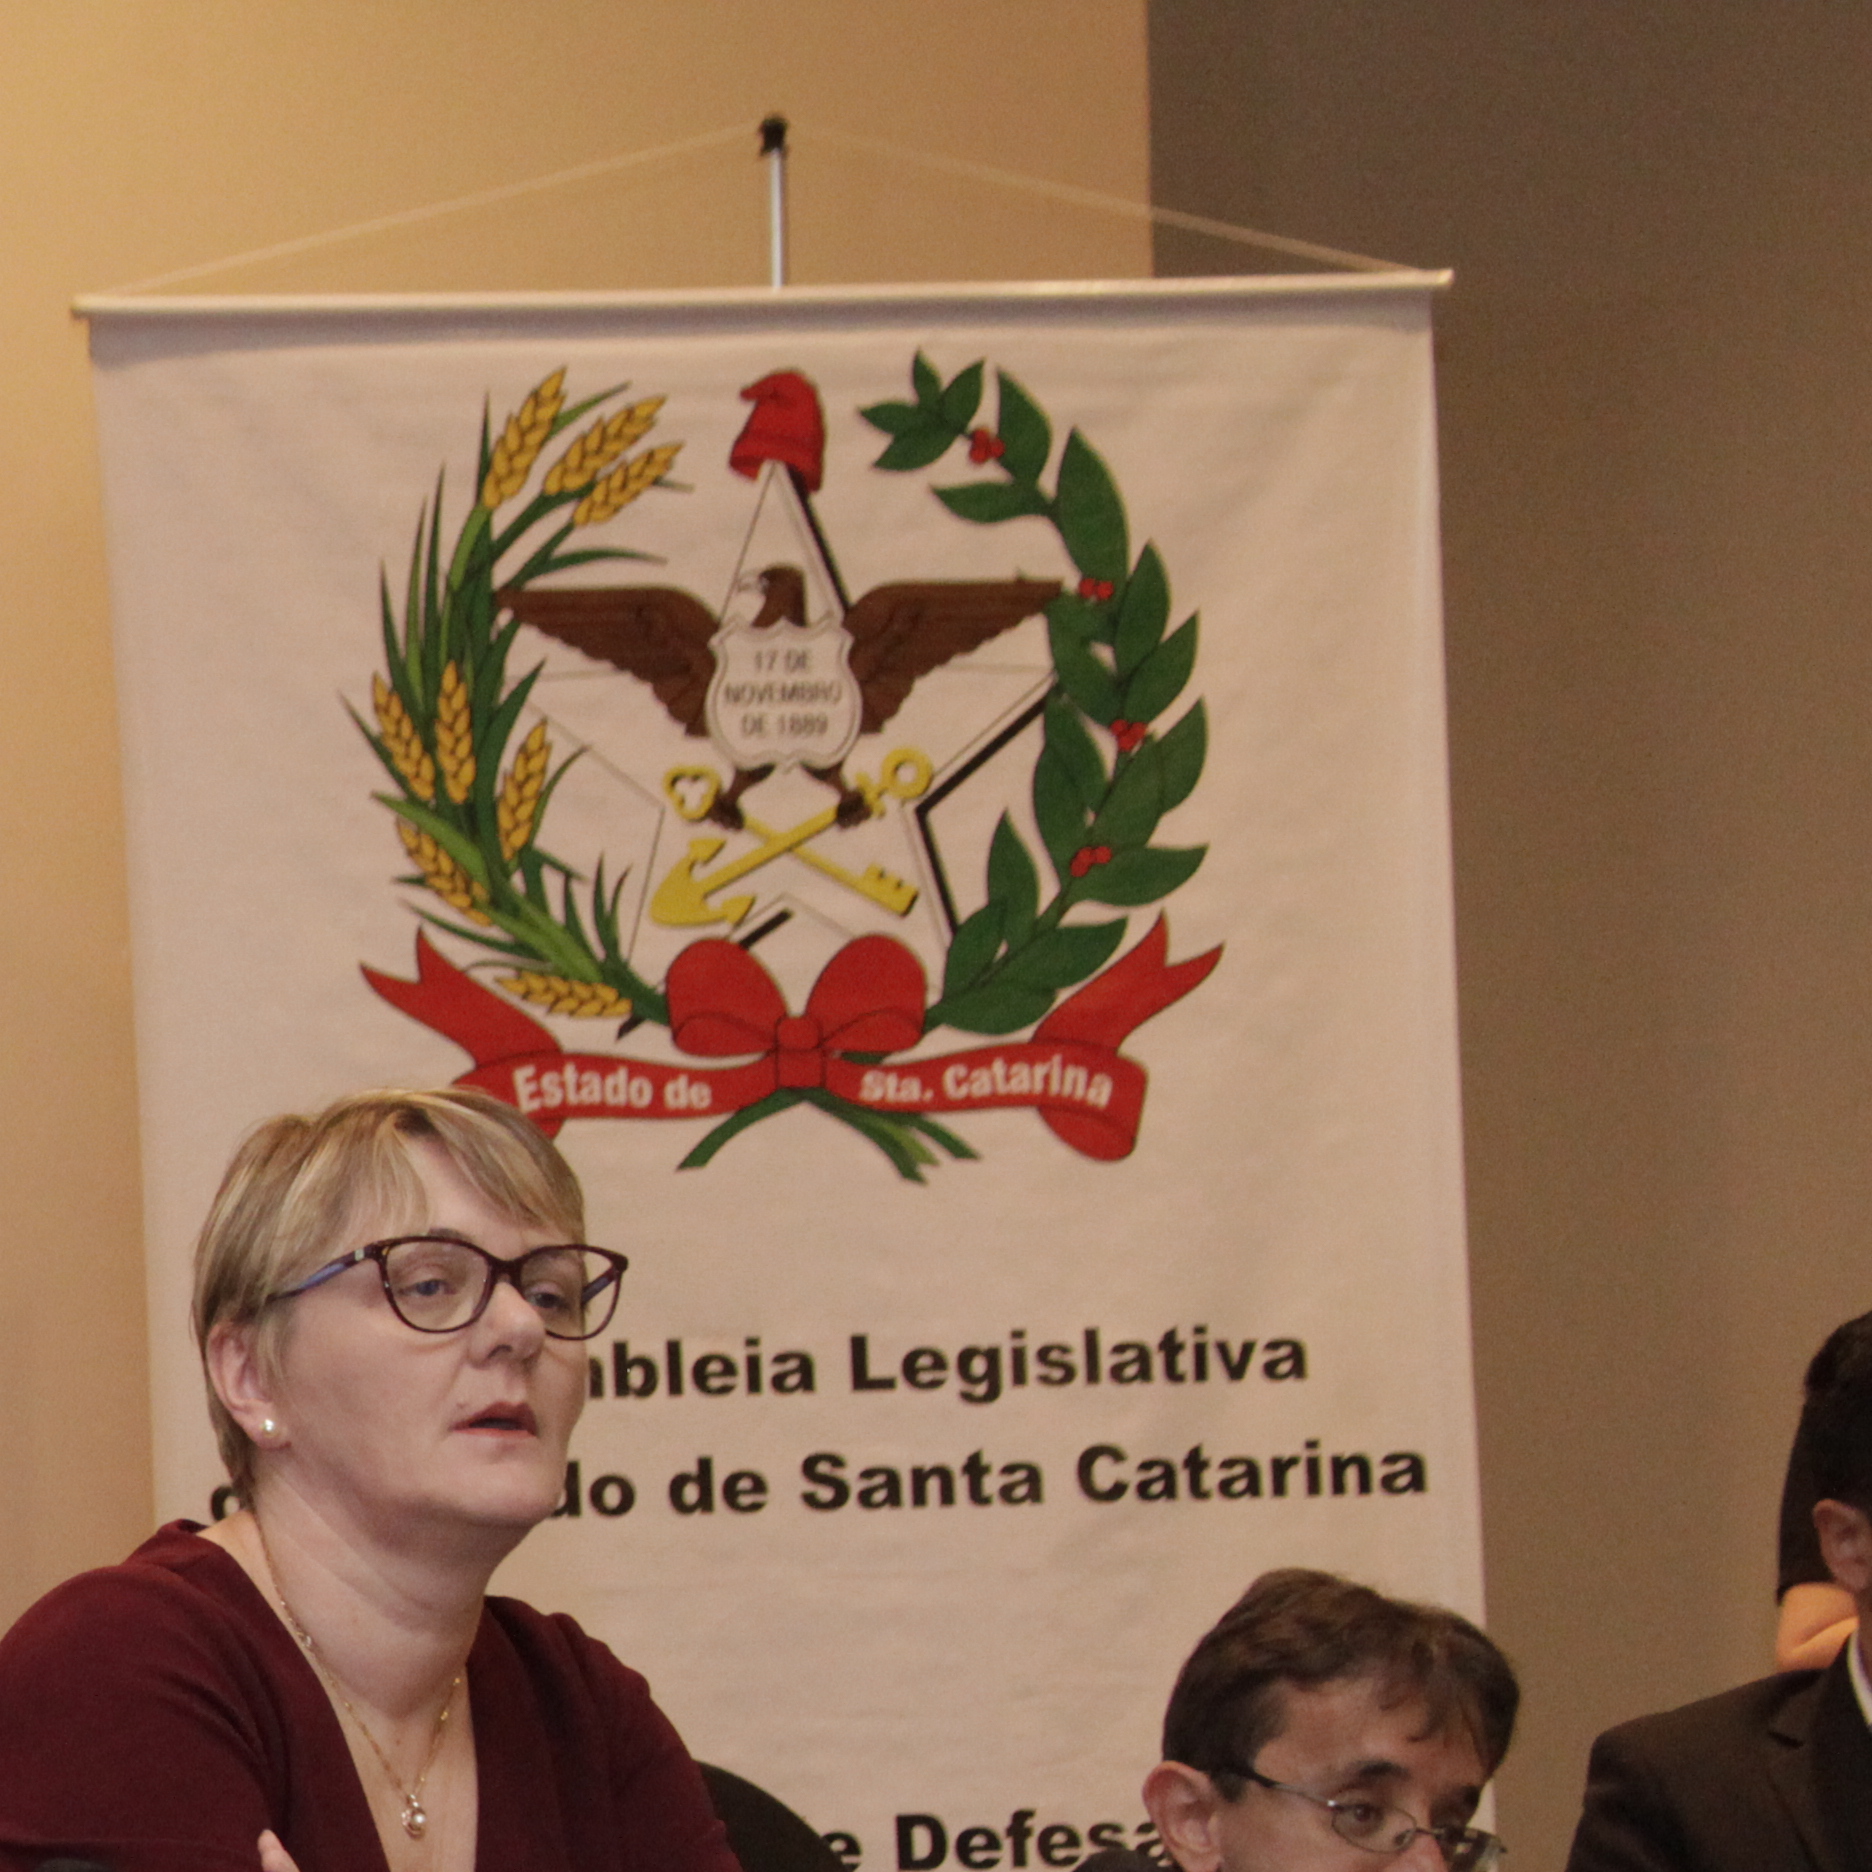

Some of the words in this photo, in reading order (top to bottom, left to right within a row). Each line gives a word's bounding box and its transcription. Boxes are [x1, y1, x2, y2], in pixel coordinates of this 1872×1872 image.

[754, 649, 779, 671] 17
[724, 681, 842, 706] NOVEMBRO
[511, 1062, 653, 1113] Estado
[663, 1073, 712, 1110] de
[860, 1068, 933, 1103] Sta.
[941, 1053, 1114, 1110] Catarina
[589, 1337, 816, 1399] bleia
[850, 1324, 1309, 1405] Legislativa
[668, 1456, 769, 1515] de
[800, 1448, 1044, 1512] Santa
[1076, 1438, 1429, 1504] Catarina
